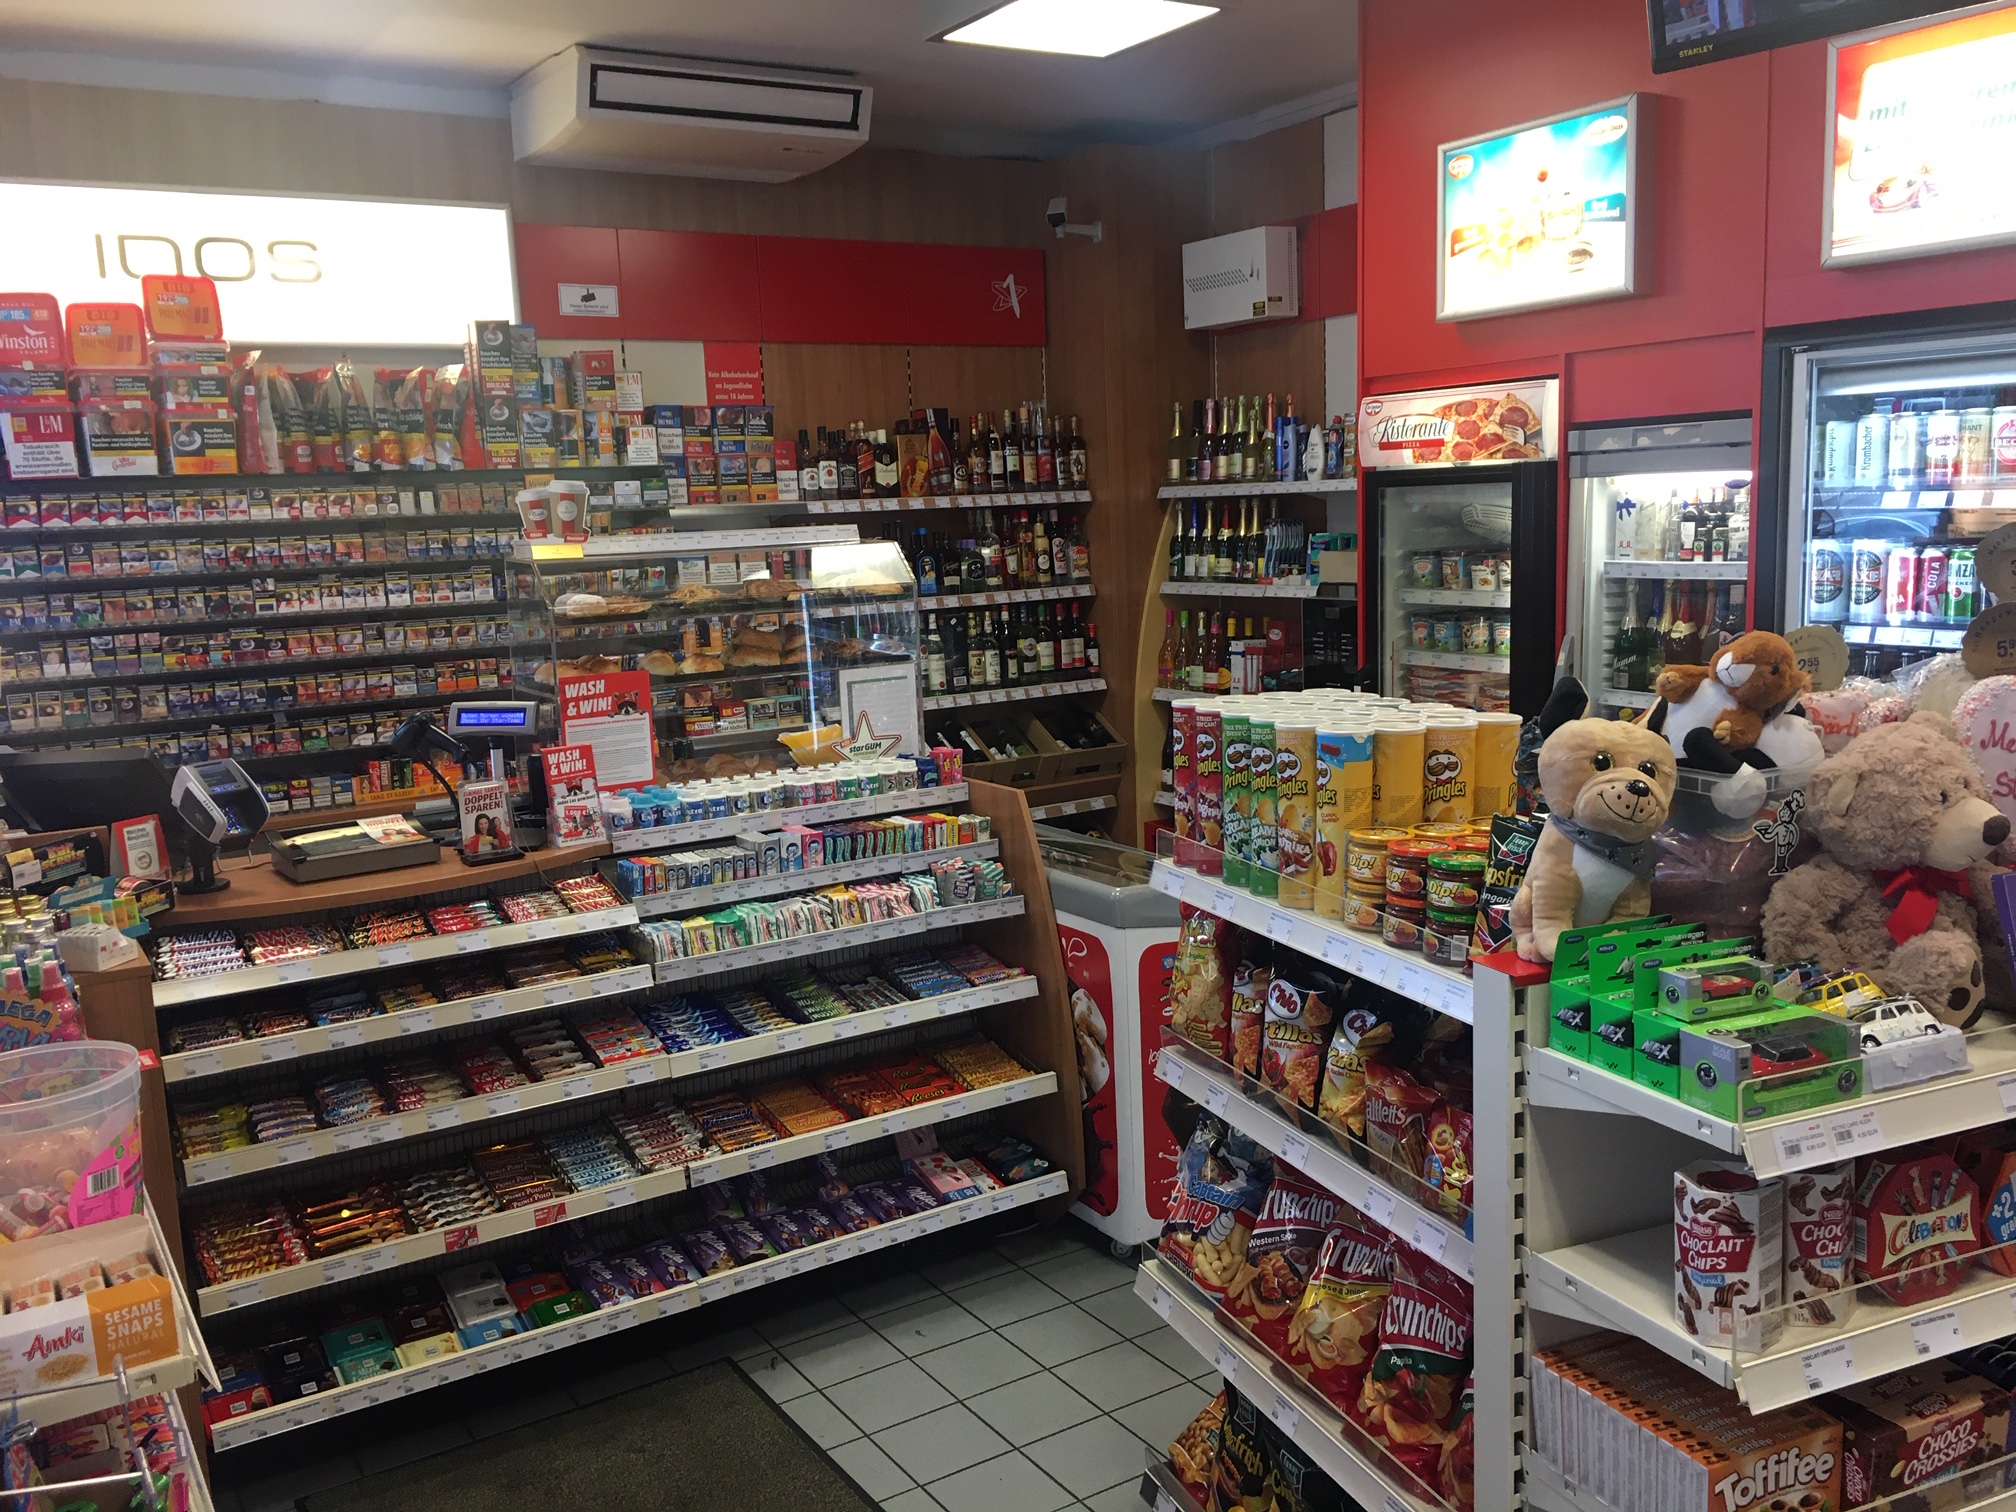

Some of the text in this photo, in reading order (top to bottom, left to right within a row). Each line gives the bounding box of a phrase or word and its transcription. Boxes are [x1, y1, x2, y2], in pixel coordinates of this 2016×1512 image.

[1679, 44, 1713, 58] STANLEY
[1869, 101, 1908, 121] mit
[95, 233, 323, 283] IQOS
[720, 371, 759, 379] Alkoholverkauf
[723, 382, 753, 391] Jugendliche
[1374, 414, 1450, 444] Ristorante
[1861, 426, 1873, 471] Krombacher
[956, 468, 966, 476] 43
[1929, 561, 1941, 589] COLA
[564, 679, 605, 699] WASH
[566, 696, 612, 716] & WIN!
[547, 749, 580, 765] WASH
[550, 759, 587, 776] & WIN!
[464, 791, 503, 806] DOPPELT
[577, 795, 596, 803] gewinnt!
[1424, 781, 1466, 804] Pringles
[464, 801, 503, 815] SPAREN!
[1508, 844, 1524, 854] frisch
[1350, 855, 1375, 870] Dip!
[1429, 880, 1460, 901] Dip!
[1664, 931, 1704, 942] Volkswagen
[1711, 945, 1752, 955] Volkswagen
[182, 957, 242, 971] SNICKERS
[1270, 982, 1299, 1014] Chio
[1556, 1007, 1584, 1026] NEX
[1598, 1023, 1626, 1042] NEX
[1641, 1039, 1672, 1060] NEX
[1711, 1051, 1732, 1062] MODEL
[1713, 1044, 1730, 1056] SCALE
[911, 1088, 945, 1103] Reese's
[1831, 1118, 1872, 1131] RETRO CARS KLEIN
[1868, 1129, 1878, 1137] EUR
[872, 1188, 895, 1205] Milka
[906, 1186, 937, 1207] Milka
[1188, 1174, 1246, 1209] Captain
[842, 1199, 864, 1215] Milka
[775, 1215, 798, 1232] Milka
[806, 1208, 830, 1227] Milka
[735, 1220, 763, 1243] Milka
[1692, 1222, 1713, 1235] Nestlé
[698, 1230, 727, 1250] Milka
[1249, 1234, 1279, 1247] Western
[1681, 1230, 1744, 1254] CHOCLAIT
[660, 1246, 683, 1264] Milka
[1688, 1252, 1727, 1270] CHIPS
[105, 1299, 162, 1326] SESAME
[107, 1312, 164, 1341] SNAPS
[1385, 1293, 1467, 1352] Crunchips
[22, 1325, 85, 1361] Amki
[107, 1328, 165, 1351] NATURAL
[1802, 1345, 1846, 1362] CHOCLAIT CHIPS CLASSIC
[1615, 1367, 1654, 1382] Toffifee
[1631, 1376, 1670, 1392] Toffifee
[1647, 1386, 1686, 1402] Toffifee
[1662, 1395, 1702, 1412] Toffifee
[1680, 1405, 1721, 1422] Toffifee
[1697, 1415, 1738, 1434] Toffifee
[1714, 1426, 1756, 1444] Toffifee
[1918, 1419, 1972, 1458] CHOCO
[1730, 1437, 1774, 1455] Toffifee
[1903, 1431, 1978, 1485] CROSSIES
[1715, 1446, 1835, 1512] Toffifee
[1852, 1465, 1863, 1503] CHOCO
